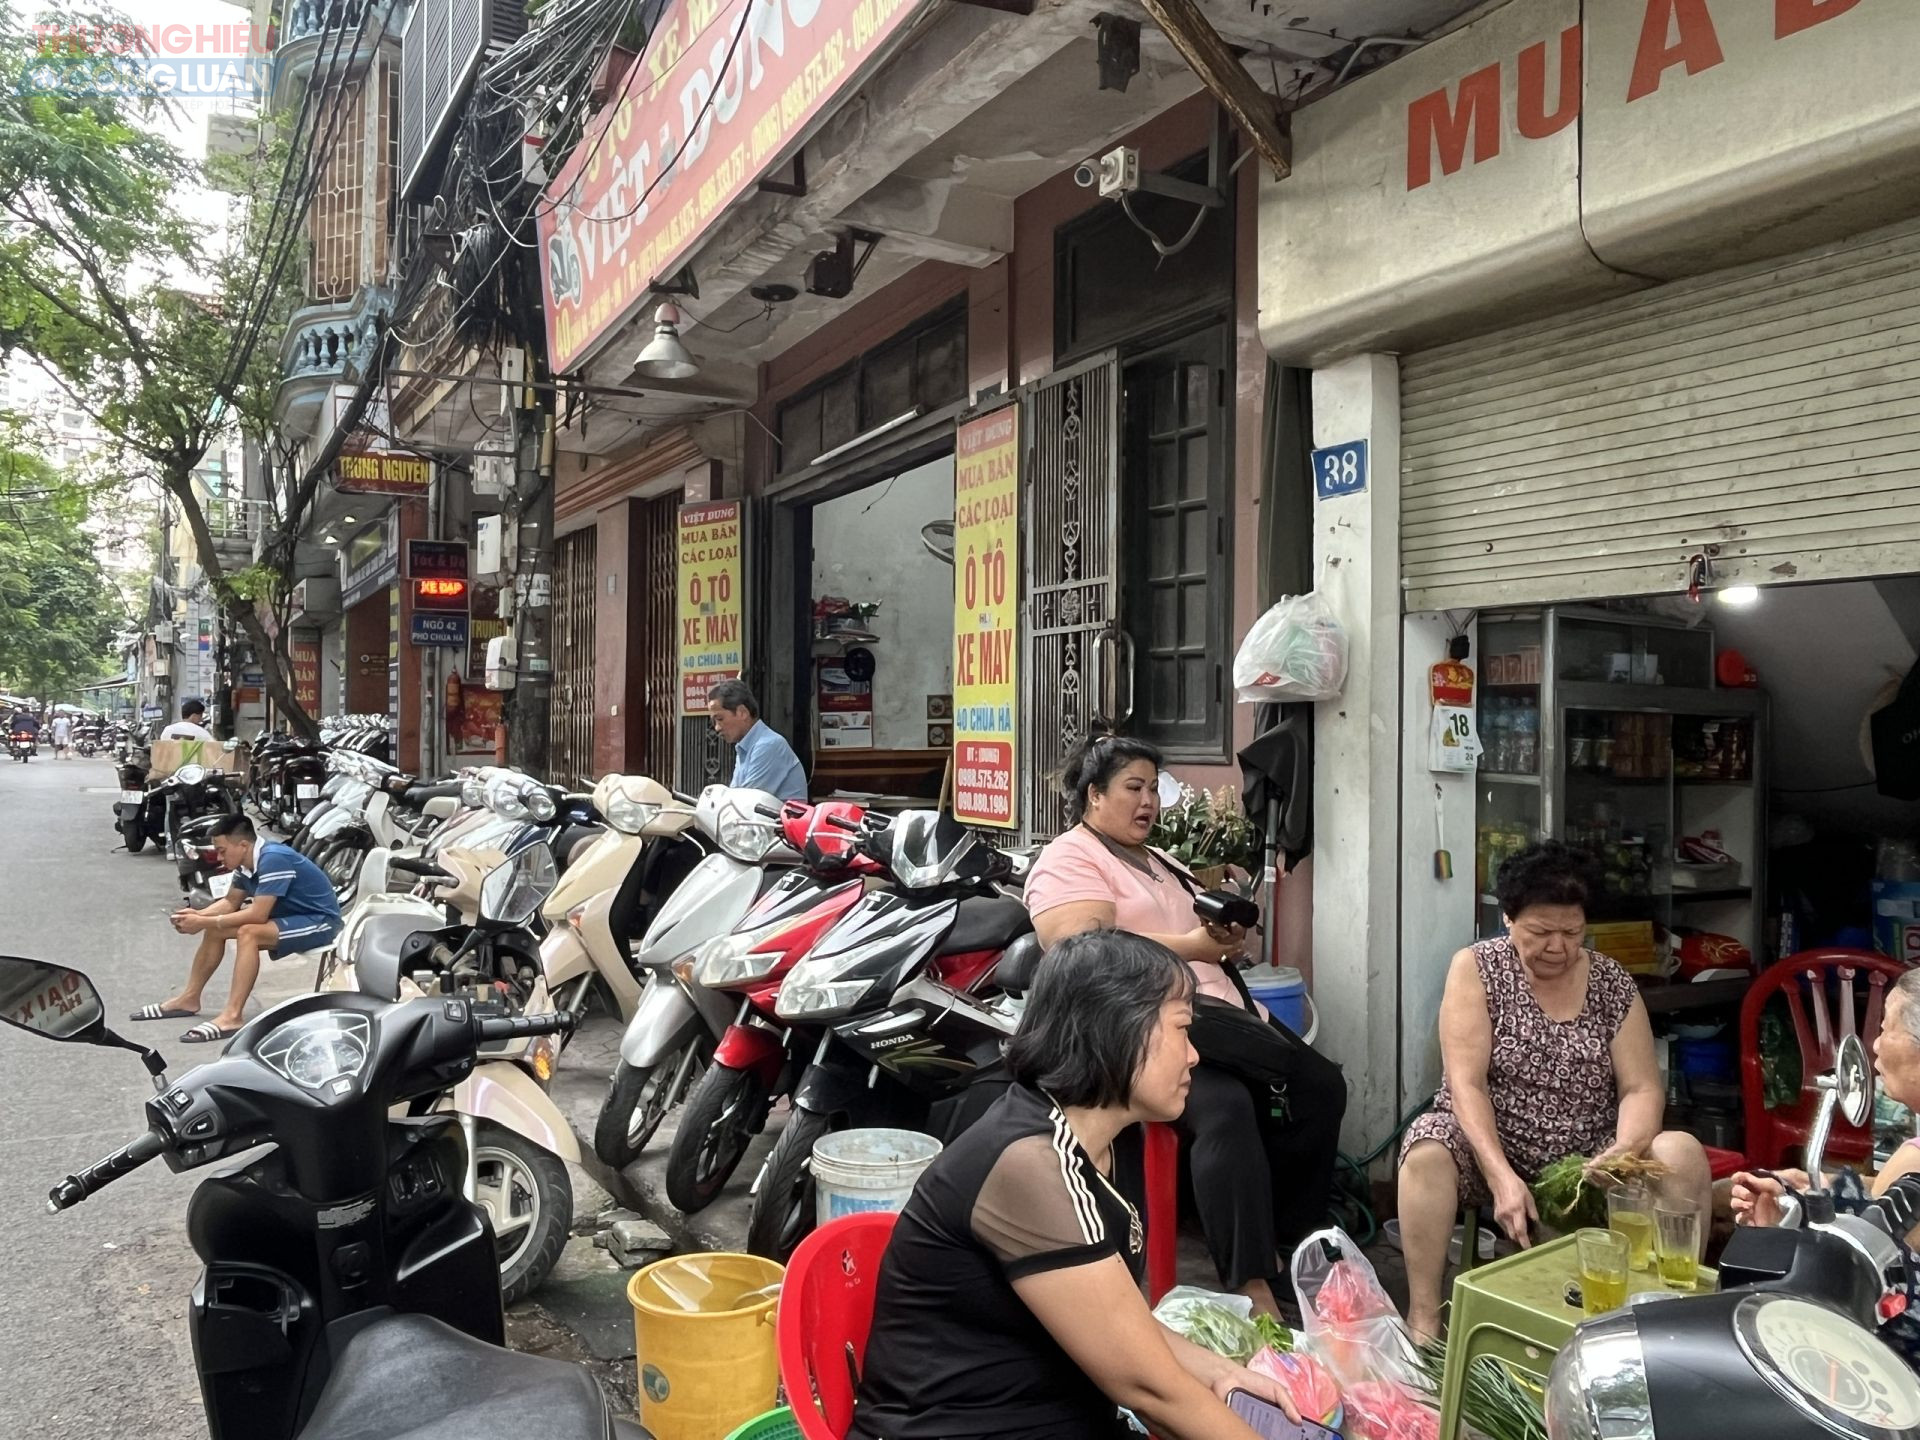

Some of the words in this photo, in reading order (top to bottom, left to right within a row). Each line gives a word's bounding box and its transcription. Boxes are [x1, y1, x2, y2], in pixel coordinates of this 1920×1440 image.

[578, 139, 650, 282] VIỆT
[958, 463, 984, 492] MUA
[988, 449, 1014, 482] BÁN
[1324, 449, 1358, 490] 38
[958, 497, 981, 529] CÁC
[984, 491, 1014, 526] LOẠI
[681, 530, 708, 546] MUA
[711, 523, 738, 541] BÁN
[681, 547, 706, 564] CÁC
[708, 543, 738, 562] LOẠI
[690, 571, 701, 606] Ô
[707, 568, 731, 603] TÔ
[965, 544, 976, 610] Ô
[982, 538, 1005, 607] TÔ
[446, 620, 457, 631] 42
[683, 617, 701, 646] XE
[705, 607, 738, 644] MÁY
[293, 650, 316, 662] MUA
[683, 655, 695, 668] 40
[957, 632, 974, 687] XE
[979, 617, 1012, 686] MÁY
[956, 707, 967, 731] 40
[970, 701, 995, 732] CHÙA
[998, 701, 1011, 732] HÀ
[1449, 713, 1470, 737] 18
[870, 1033, 915, 1049] HONDA
